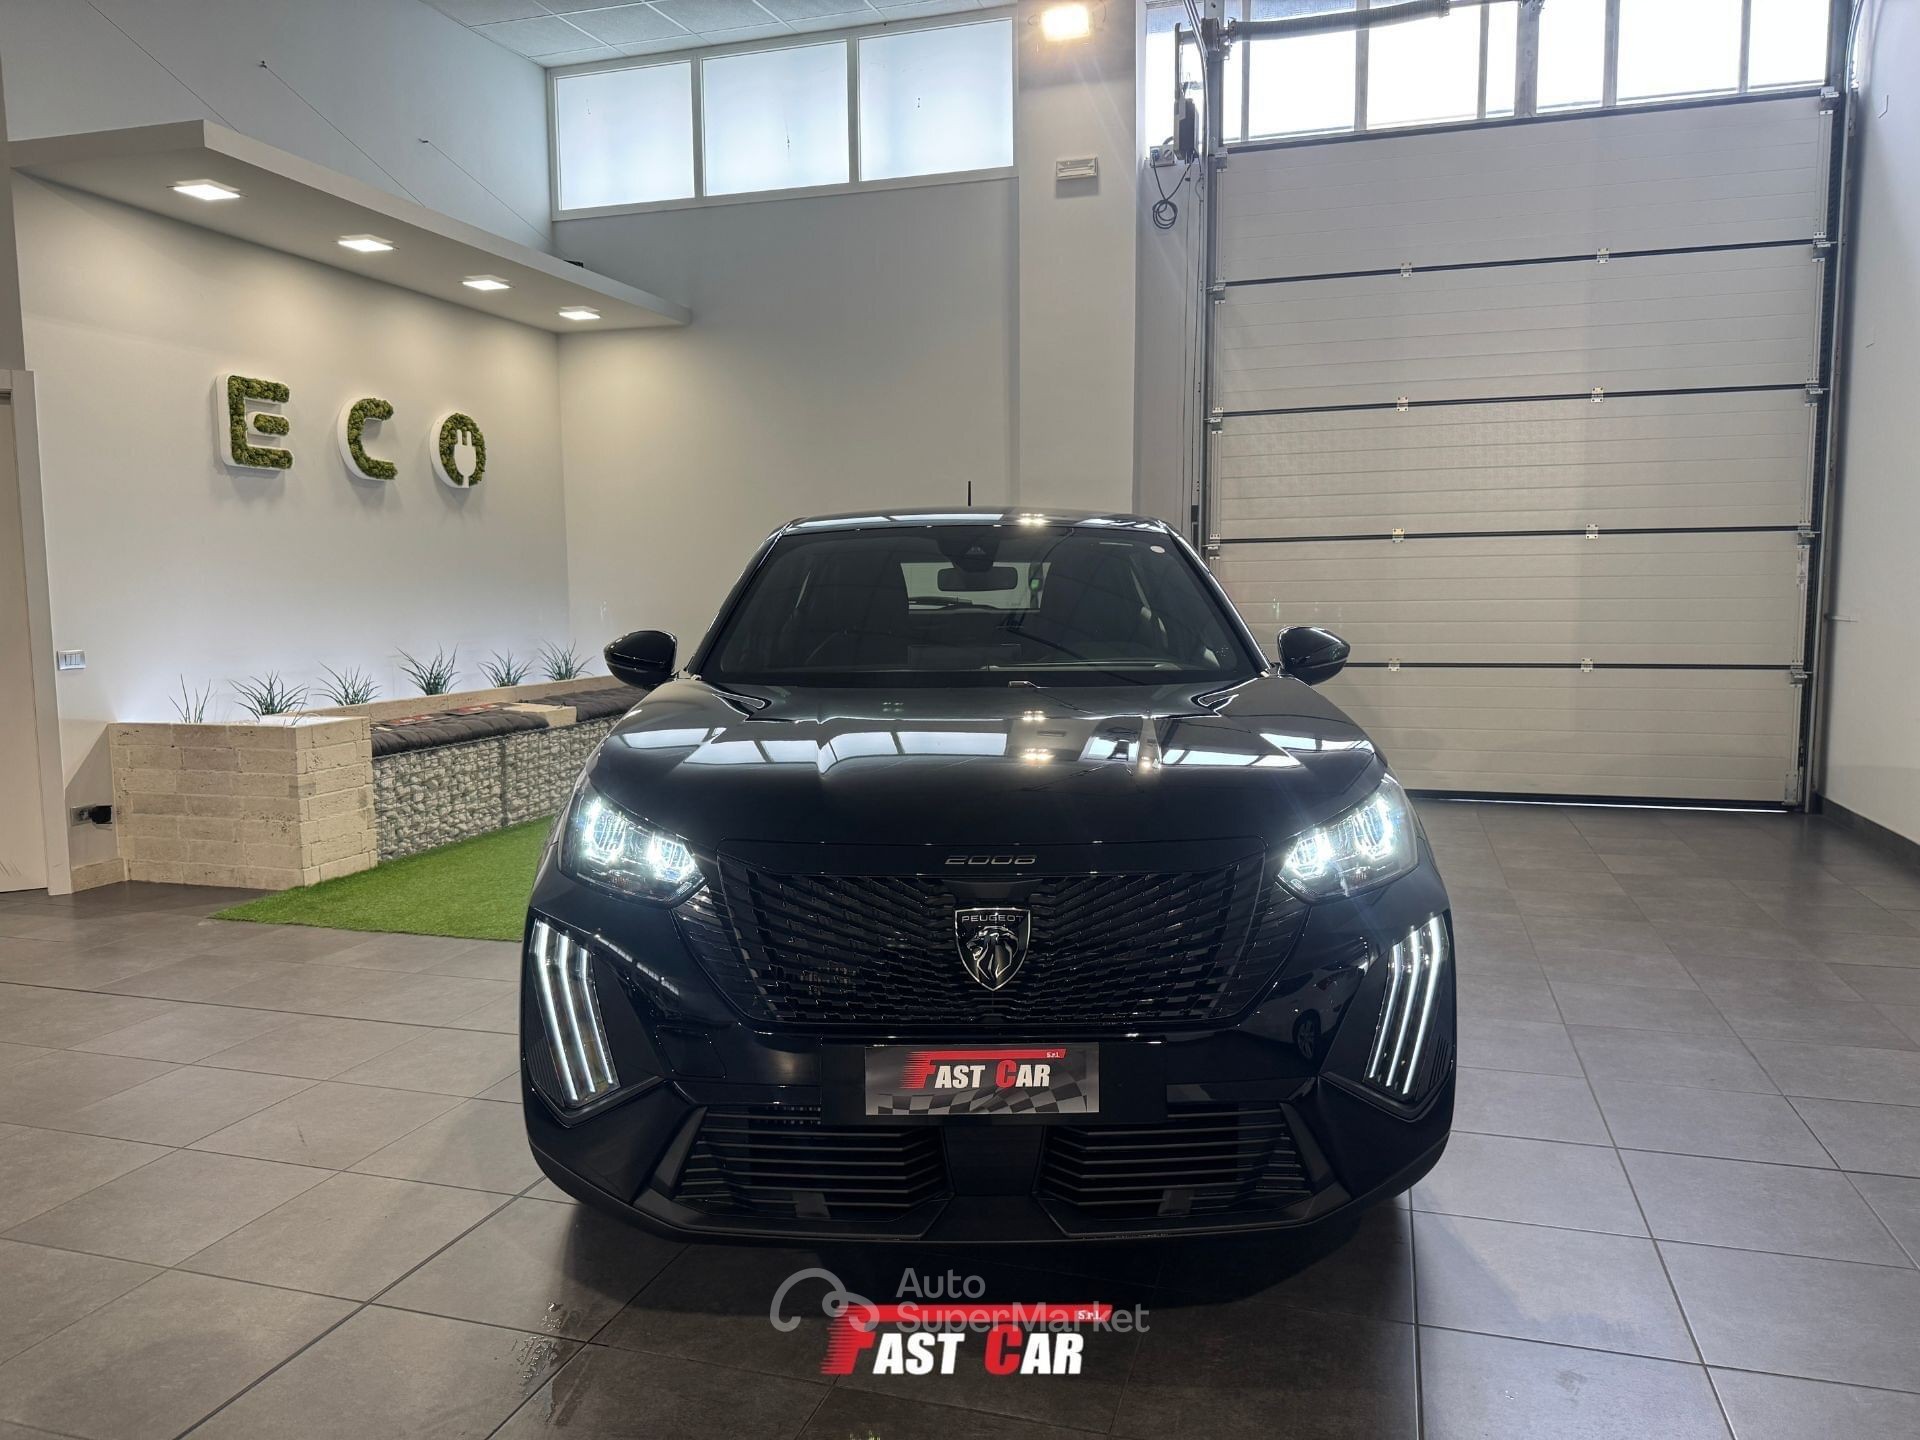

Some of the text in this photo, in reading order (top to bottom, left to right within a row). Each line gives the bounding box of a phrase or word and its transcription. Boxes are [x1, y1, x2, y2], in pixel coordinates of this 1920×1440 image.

[216, 374, 486, 488] ECO
[945, 855, 1037, 865] 2008
[961, 914, 1024, 922] PEUGEOT
[901, 1050, 1051, 1088] FAST CAR
